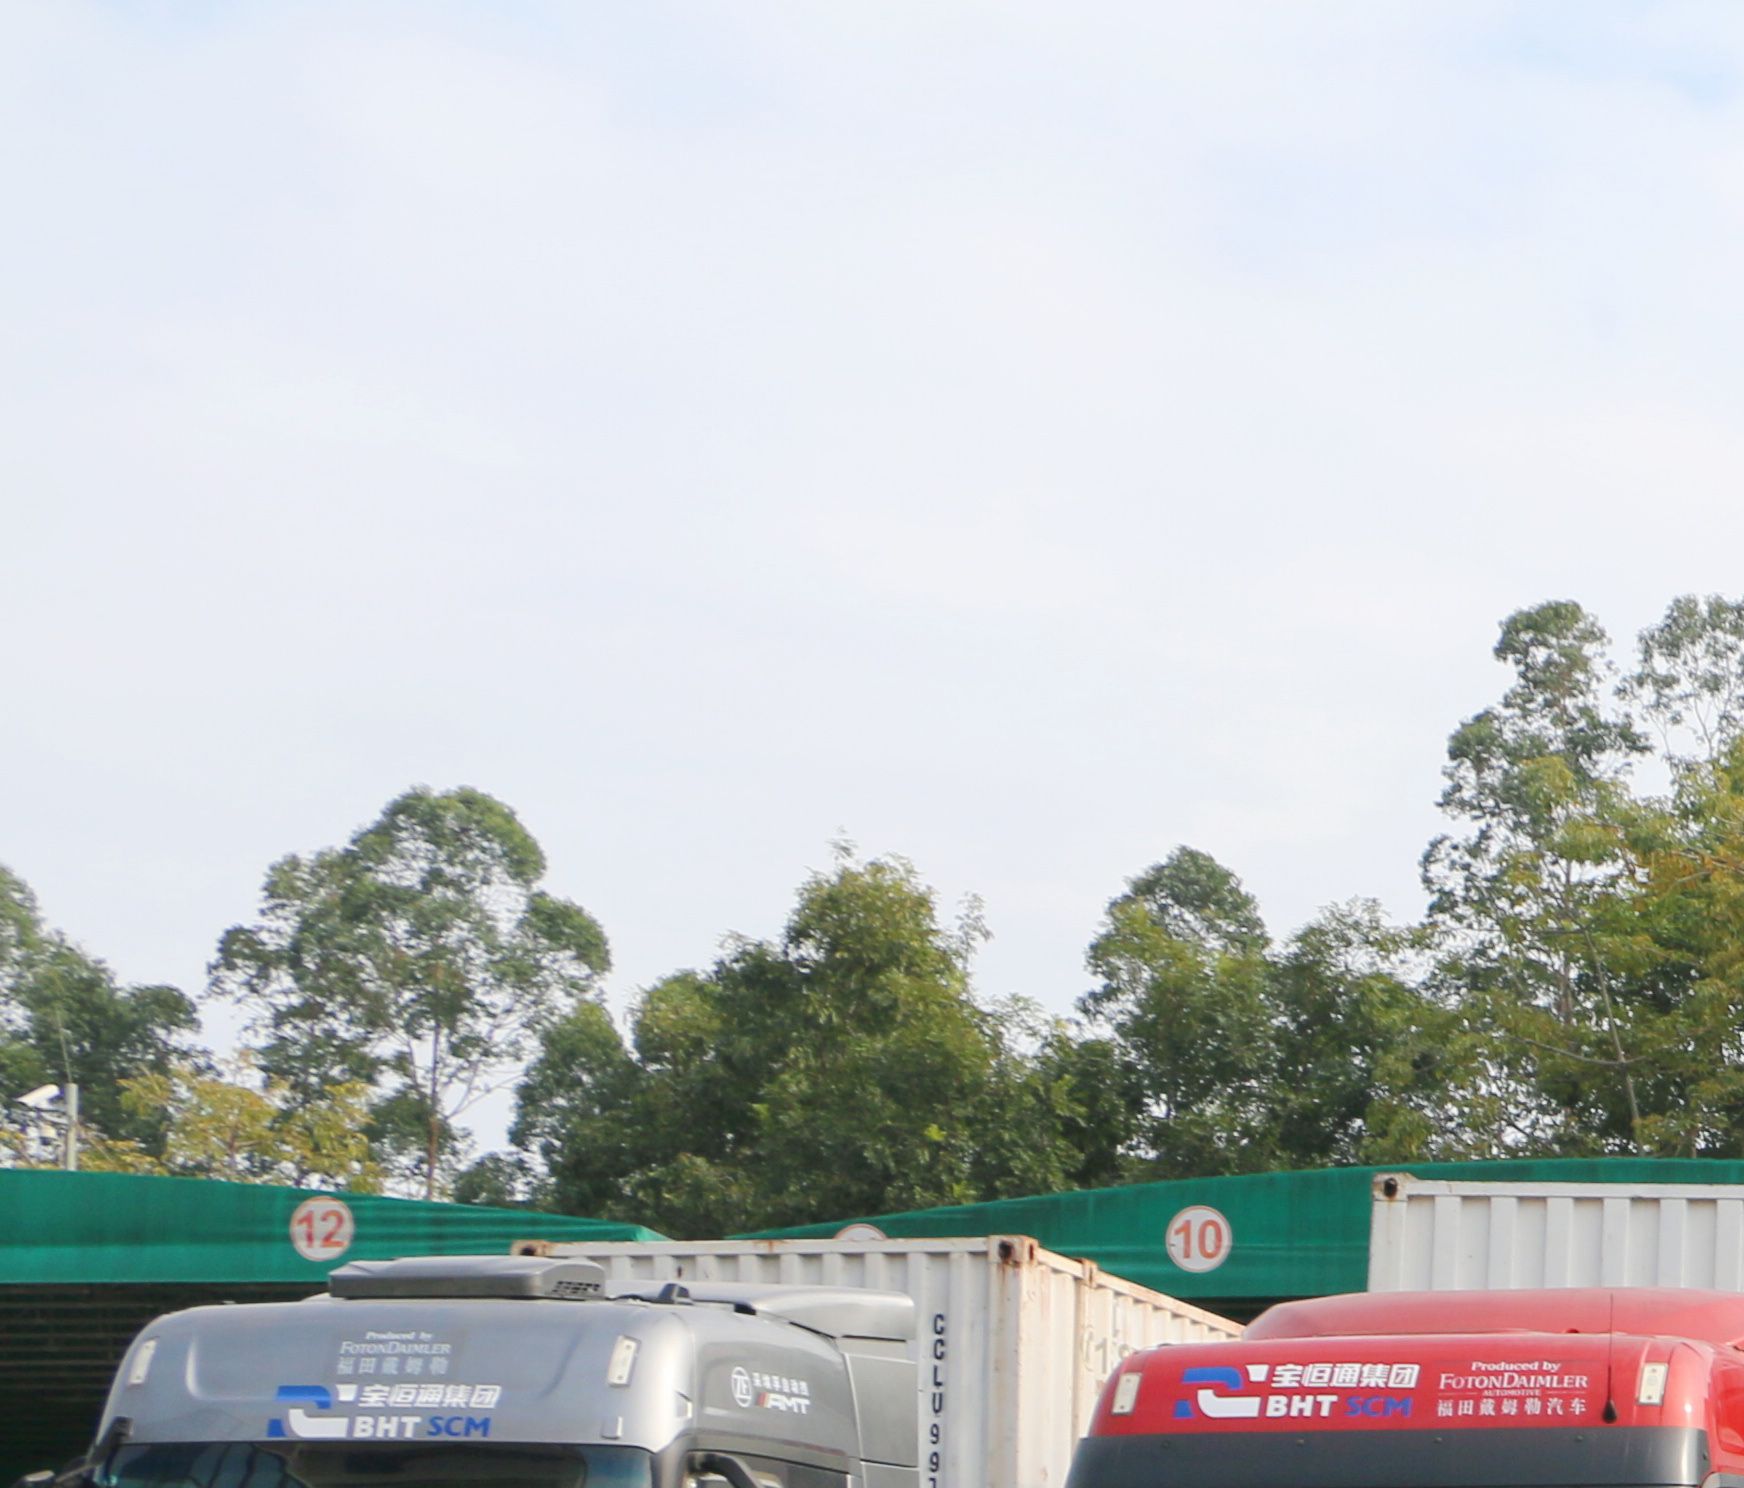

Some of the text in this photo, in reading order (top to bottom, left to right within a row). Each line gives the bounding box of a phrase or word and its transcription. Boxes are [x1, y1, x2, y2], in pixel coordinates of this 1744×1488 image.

[293, 1209, 350, 1250] 12
[1172, 1220, 1223, 1257] 10
[1270, 1363, 1420, 1389] 宝恒通集团
[1471, 1360, 1561, 1374] Produced by
[358, 1384, 502, 1409] 宝恒通集团
[1266, 1394, 1412, 1418] BHT SCM
[353, 1416, 492, 1438] BHT SCM
